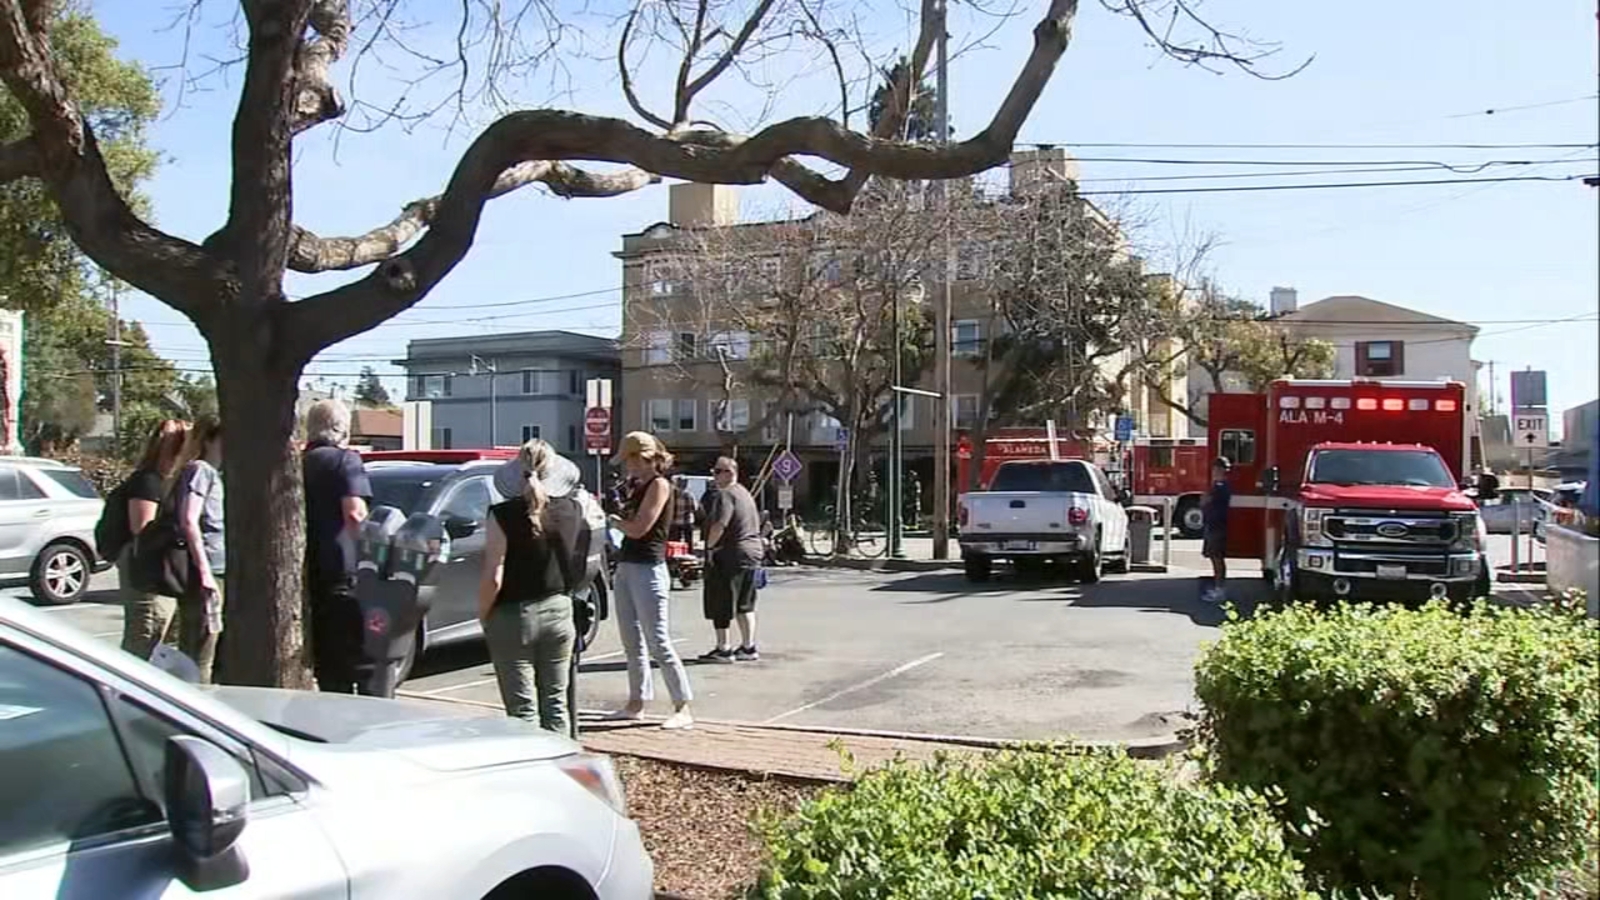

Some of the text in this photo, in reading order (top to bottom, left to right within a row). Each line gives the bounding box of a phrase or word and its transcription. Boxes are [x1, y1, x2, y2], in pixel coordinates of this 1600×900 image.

[1279, 410, 1343, 424] ALA M-4
[1518, 419, 1543, 430] EXIT
